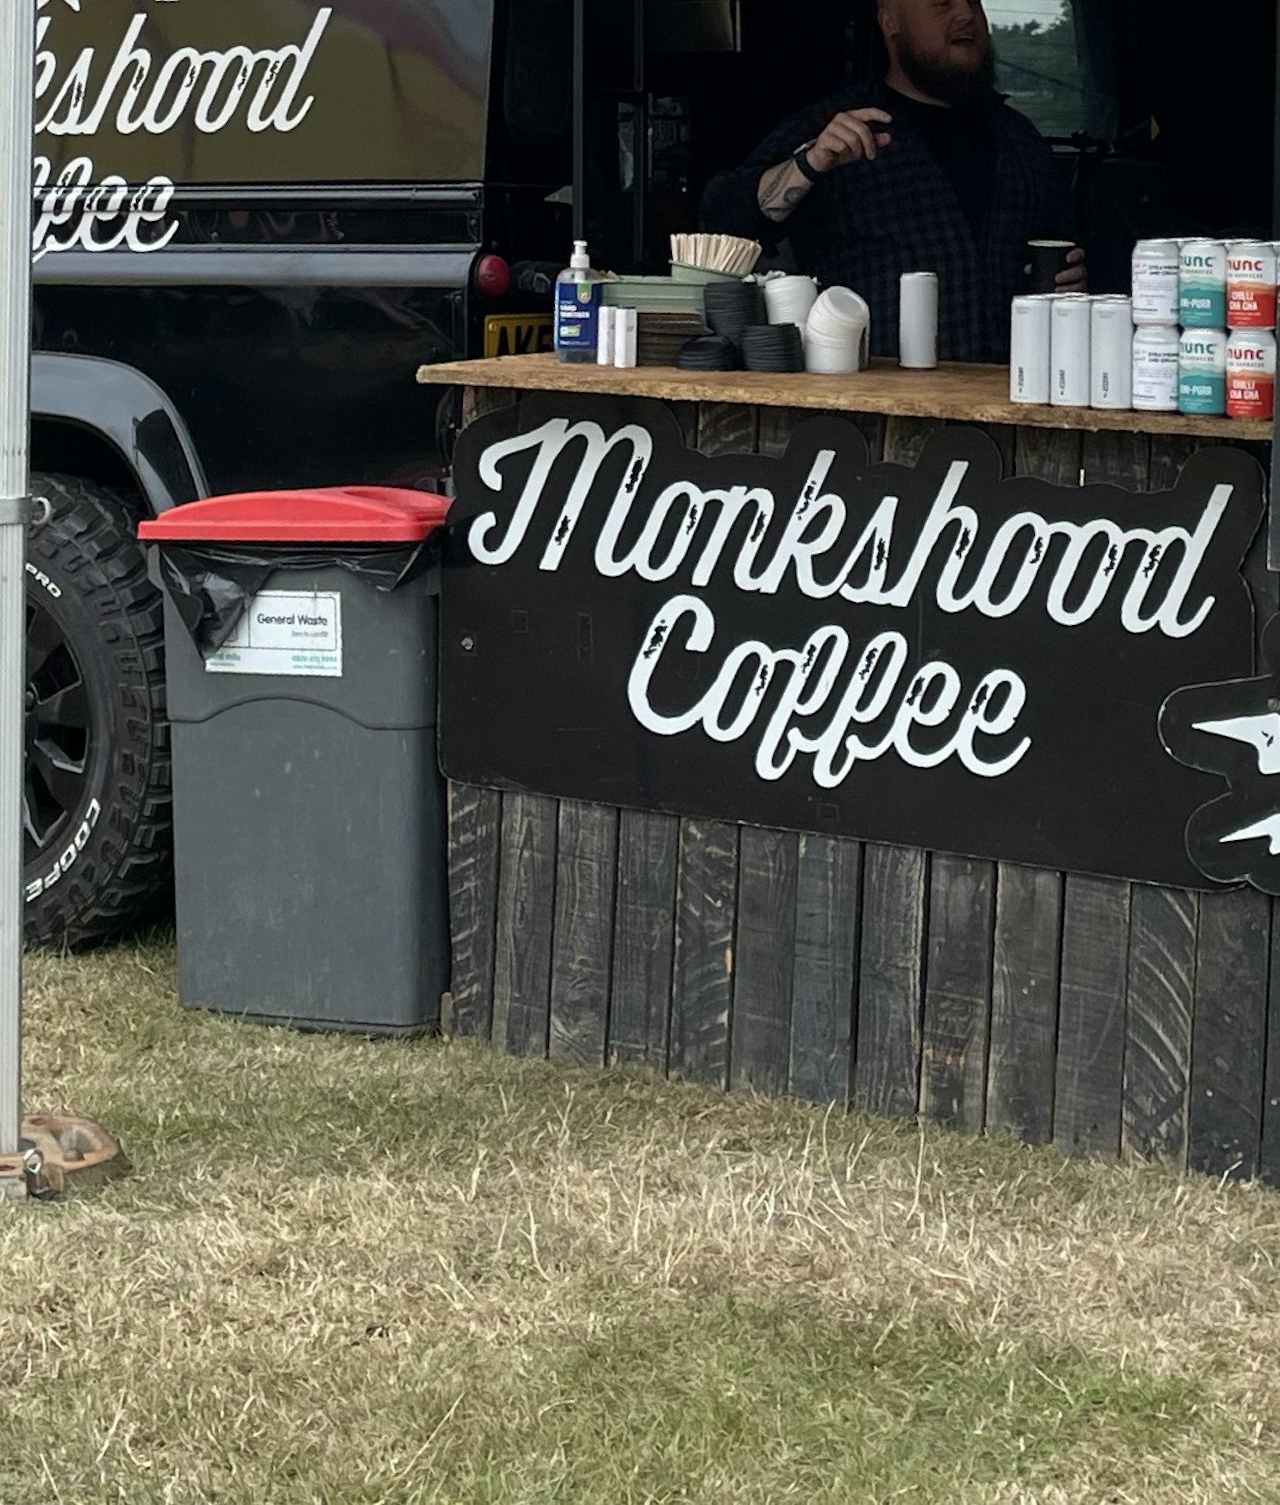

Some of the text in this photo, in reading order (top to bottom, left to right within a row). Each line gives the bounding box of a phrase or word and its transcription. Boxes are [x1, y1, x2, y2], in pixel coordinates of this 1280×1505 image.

[25, 562, 62, 598] PRO
[468, 417, 1233, 638] Monkshood
[257, 613, 328, 626] General Waste
[627, 594, 1032, 788] Coffee
[26, 797, 101, 903] COOPE
